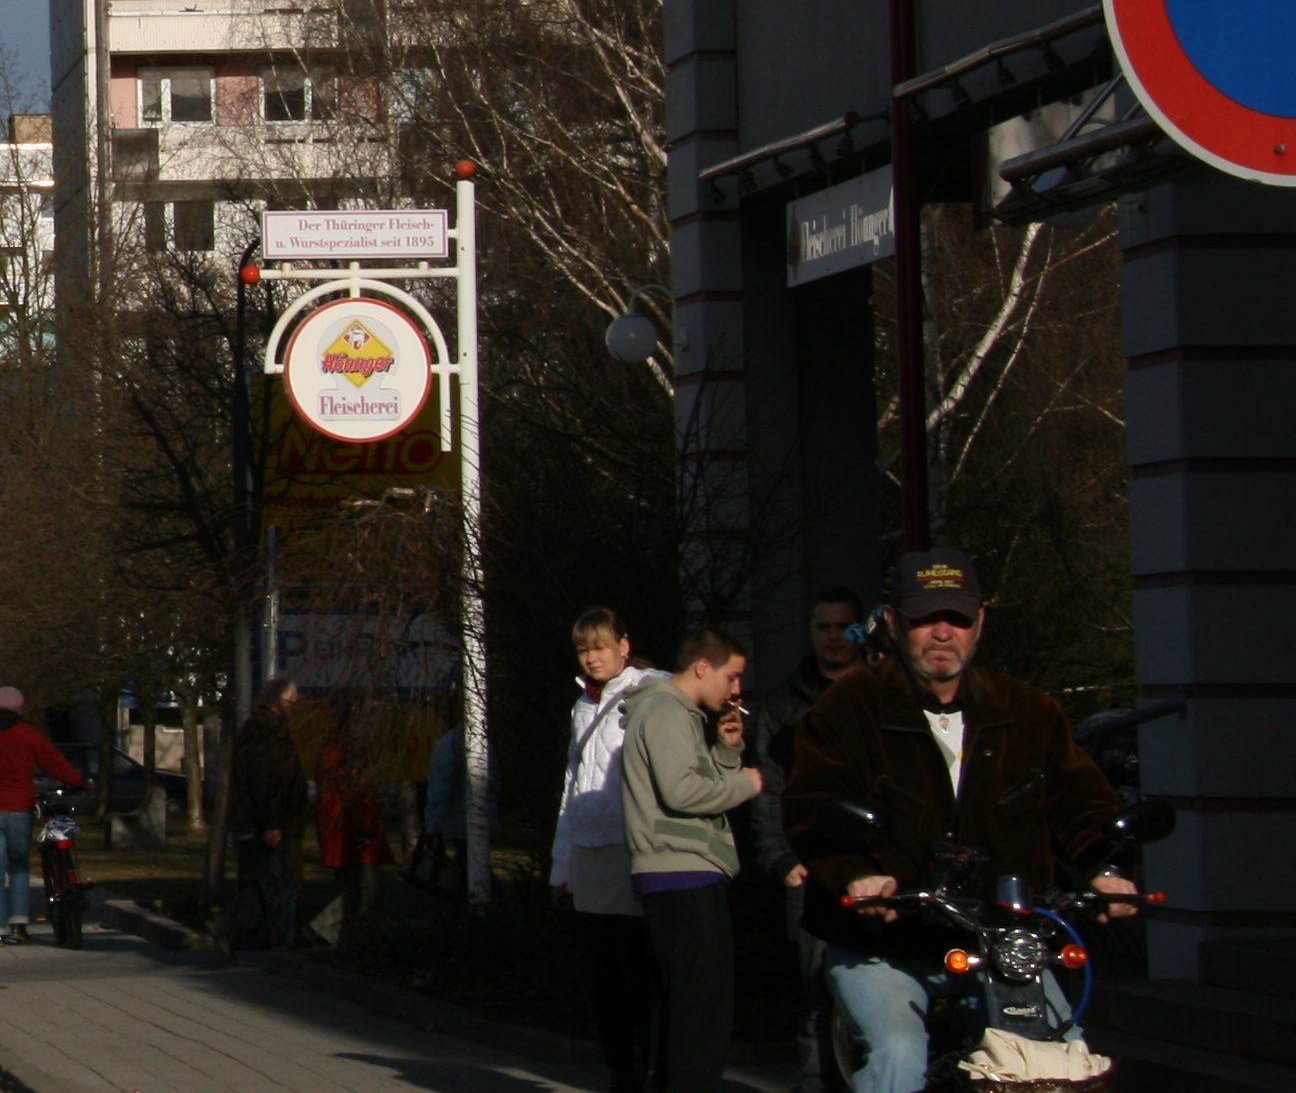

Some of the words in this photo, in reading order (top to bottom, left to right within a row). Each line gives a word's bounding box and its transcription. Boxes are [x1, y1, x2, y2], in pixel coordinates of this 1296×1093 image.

[298, 219, 321, 231] Der
[324, 218, 385, 232] Thüringer
[389, 218, 435, 230] Fleisch-
[275, 241, 286, 249] u.
[289, 236, 377, 252] Wurstspezialist
[381, 237, 401, 248] seit
[405, 236, 435, 248] 1895
[320, 395, 398, 415] Fleischerei
